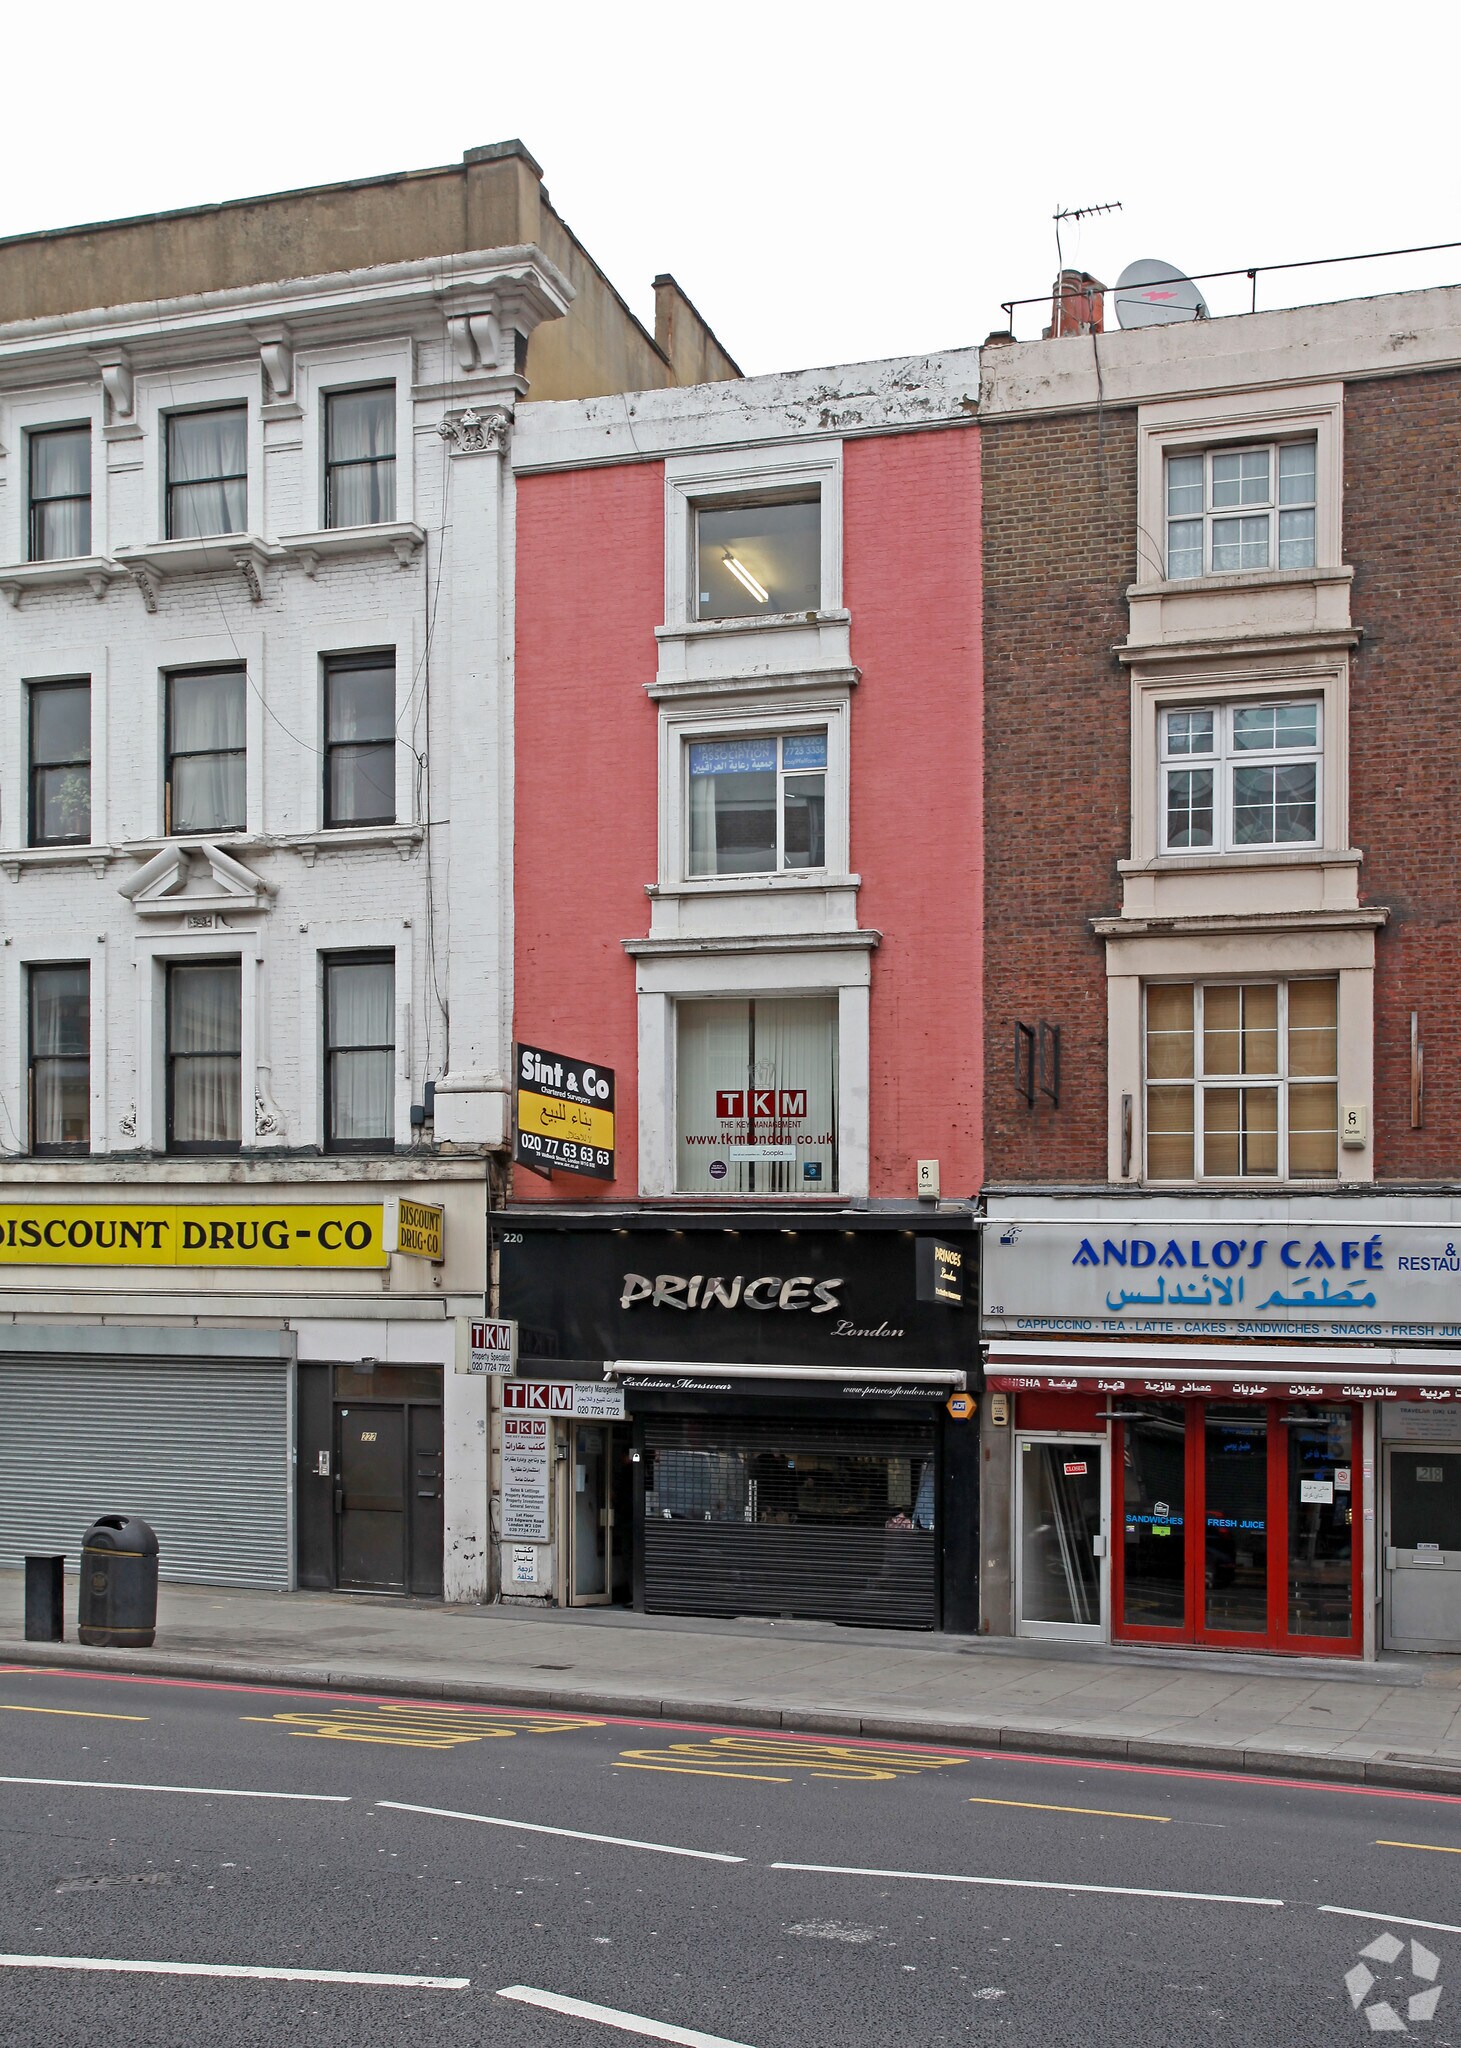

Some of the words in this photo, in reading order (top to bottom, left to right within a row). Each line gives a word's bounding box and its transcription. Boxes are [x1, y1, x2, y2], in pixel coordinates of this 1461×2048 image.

[728, 739, 771, 750] WELFARE
[701, 749, 770, 761] ASSOCIATION
[521, 1051, 564, 1088] Sint
[566, 1072, 580, 1092] &
[582, 1068, 610, 1099] Co
[541, 1086, 566, 1098] Chartered
[566, 1093, 591, 1105] Surveyors
[718, 1091, 805, 1117] TKM
[540, 1103, 566, 1126] للبيع
[571, 1108, 592, 1131] بناء
[720, 1120, 734, 1129] THE
[736, 1120, 750, 1129] KEY
[752, 1120, 802, 1129] MANAGEMENT
[521, 1133, 541, 1151] 020
[545, 1138, 559, 1154] 77
[562, 1142, 577, 1158] 63
[580, 1146, 594, 1162] 63
[596, 1150, 610, 1166] 63
[762, 1149, 784, 1157] Zoopla
[400, 1204, 440, 1232] DISCOUNT
[0, 1219, 170, 1249] ISCOUNT
[503, 1233, 523, 1243] 220
[1280, 1234, 1384, 1269] CAFÉ
[1445, 1242, 1457, 1257] &
[934, 1246, 962, 1268] PRINCES
[619, 1271, 848, 1314] PRINCES
[990, 1305, 1005, 1314] 218
[830, 1319, 906, 1337] London
[1016, 1318, 1092, 1330] CAPPUCCINO
[1101, 1320, 1126, 1331] TEA
[1135, 1321, 1173, 1332] LATTE
[1184, 1321, 1226, 1333] CAKES
[1237, 1322, 1320, 1334] SANDWICHES
[1331, 1324, 1383, 1336] SNACKS
[1391, 1325, 1435, 1336] FRESH
[473, 1324, 511, 1350] TKM
[471, 1351, 489, 1362] Property
[490, 1351, 511, 1362] Specialist
[471, 1362, 483, 1371] 020
[484, 1362, 497, 1372] 7724
[498, 1363, 511, 1373] 7722
[574, 1383, 593, 1395] Property
[622, 1376, 671, 1388] Exclusive
[671, 1378, 732, 1390] Menswear
[1001, 1378, 1041, 1389] SHISHA
[1048, 1378, 1078, 1390] شيشة
[1097, 1379, 1126, 1391] قهوة
[1144, 1381, 1176, 1393] طازجة
[1178, 1381, 1212, 1394] عصائر
[1232, 1383, 1268, 1395] حلويات
[842, 1386, 944, 1398] www.princesoflondon.com
[1289, 1385, 1324, 1396] مقبلات
[1342, 1386, 1398, 1399] ساندويشات
[1418, 1387, 1451, 1399] عربية
[505, 1385, 573, 1410] TKM
[577, 1405, 589, 1415] 020
[590, 1406, 604, 1415] 7724
[605, 1406, 620, 1416] 7722
[952, 1401, 966, 1411] ADT
[506, 1421, 547, 1434] TKM
[361, 1432, 377, 1441] 222
[505, 1441, 526, 1451] عقارات
[528, 1442, 546, 1453] مكتب
[1417, 1467, 1442, 1481] 218
[1125, 1514, 1184, 1525] SANDWICHES
[1207, 1518, 1237, 1528] FRESH
[1239, 1520, 1265, 1529] JUICE
